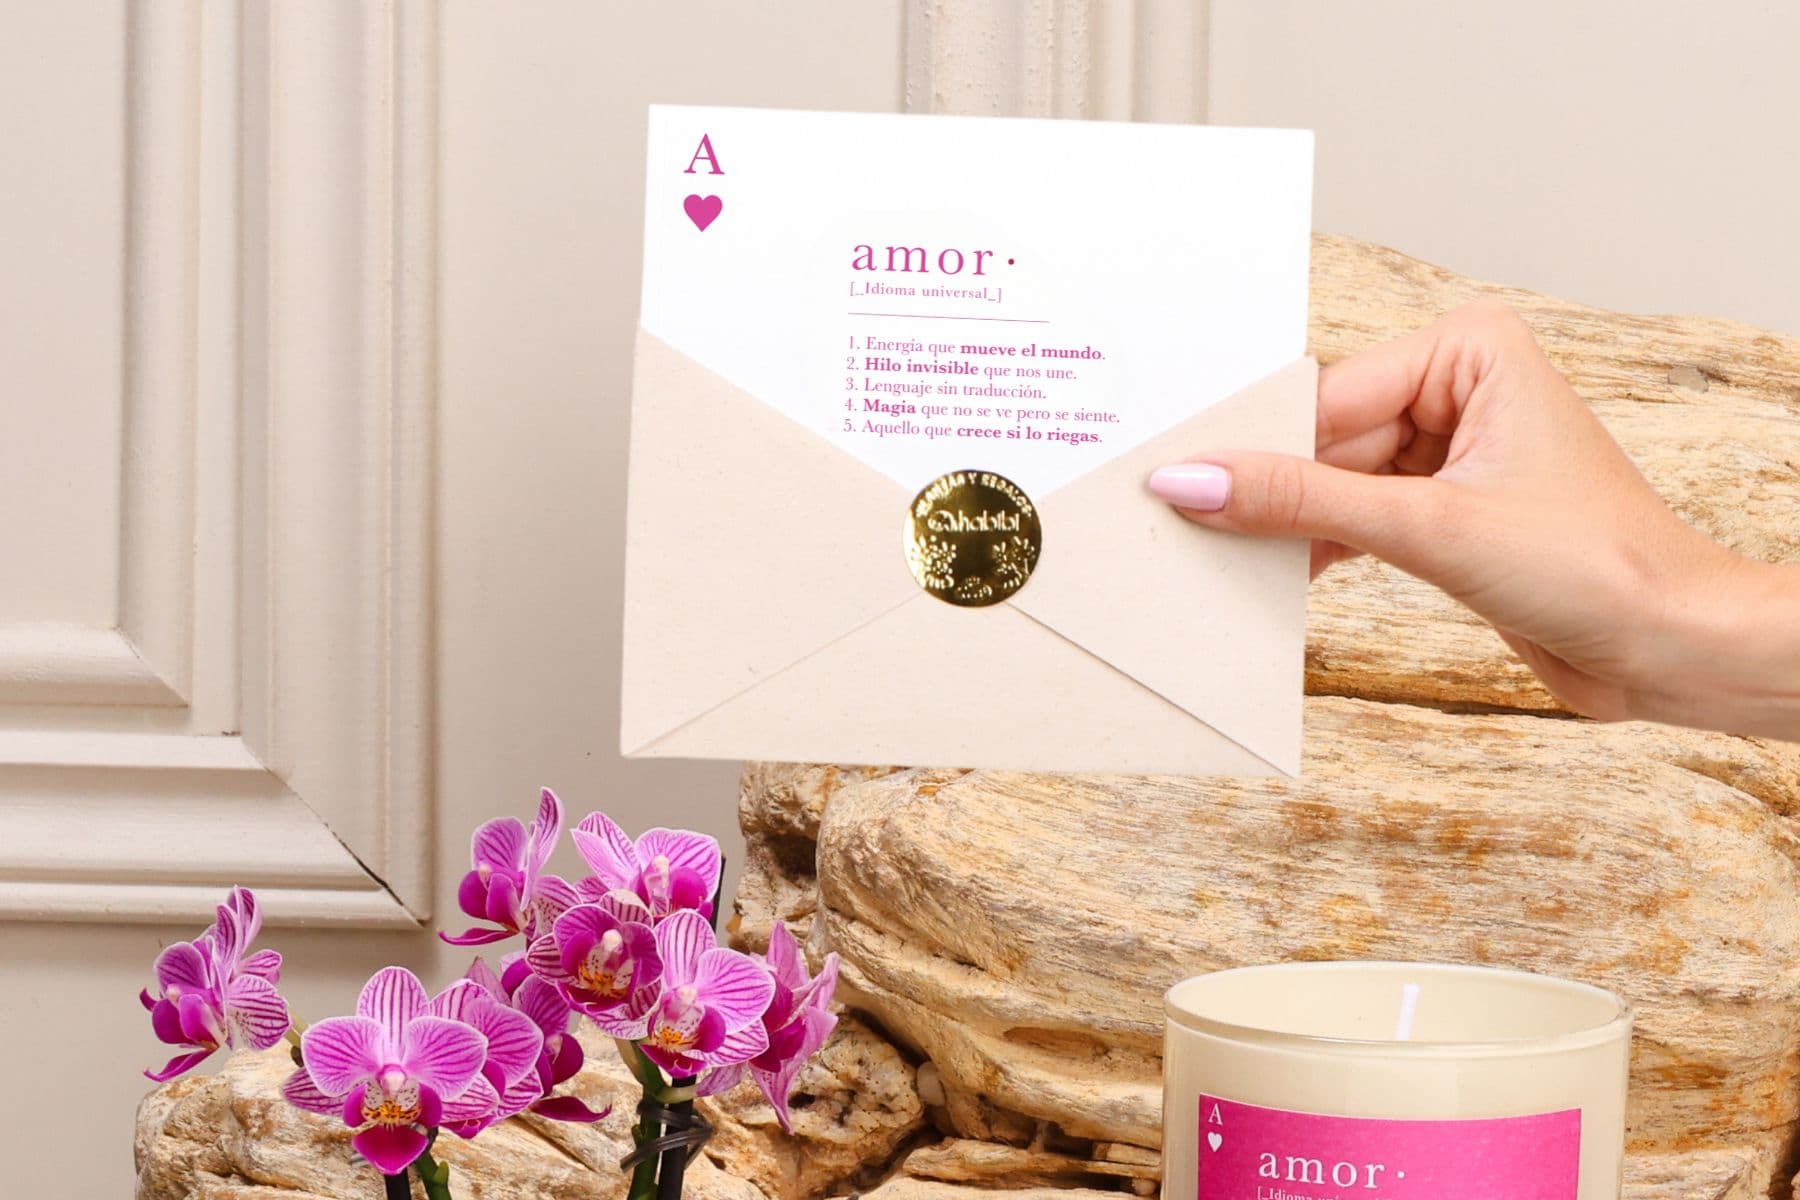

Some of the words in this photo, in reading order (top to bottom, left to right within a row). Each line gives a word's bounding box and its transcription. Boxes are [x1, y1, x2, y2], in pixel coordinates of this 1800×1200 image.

[683, 133, 725, 175] A
[849, 336, 860, 350] 1.
[866, 337, 923, 352] Energía
[928, 342, 955, 356] que
[960, 344, 1016, 356] mueve
[1021, 344, 1036, 357] el
[1041, 346, 1106, 360] mundo.
[846, 357, 859, 371] 2.
[865, 357, 901, 372] Hilo
[907, 359, 978, 375] invisible
[984, 365, 1011, 380] que
[1016, 367, 1041, 378] nos
[1046, 368, 1077, 380] une.
[846, 378, 858, 391] 3.
[864, 378, 932, 398] Lenguaje
[937, 381, 957, 395] sin
[963, 384, 1047, 399] traducción.
[844, 399, 857, 412] 4.
[863, 399, 916, 418] Magia
[921, 404, 948, 418] que
[954, 405, 972, 417] no
[977, 406, 990, 417] se
[997, 407, 1012, 418] ve
[1017, 408, 1050, 426] pero
[1055, 409, 1069, 420] se
[1074, 408, 1120, 423] siente.
[843, 419, 856, 433] 5.
[862, 420, 920, 437] Aquello
[924, 425, 952, 439] que
[957, 425, 1001, 438] crece
[1007, 426, 1021, 439] si
[1026, 426, 1042, 440] lo
[1047, 428, 1102, 446] riegas.
[968, 473, 977, 484] Y
[1207, 1104, 1223, 1125] A
